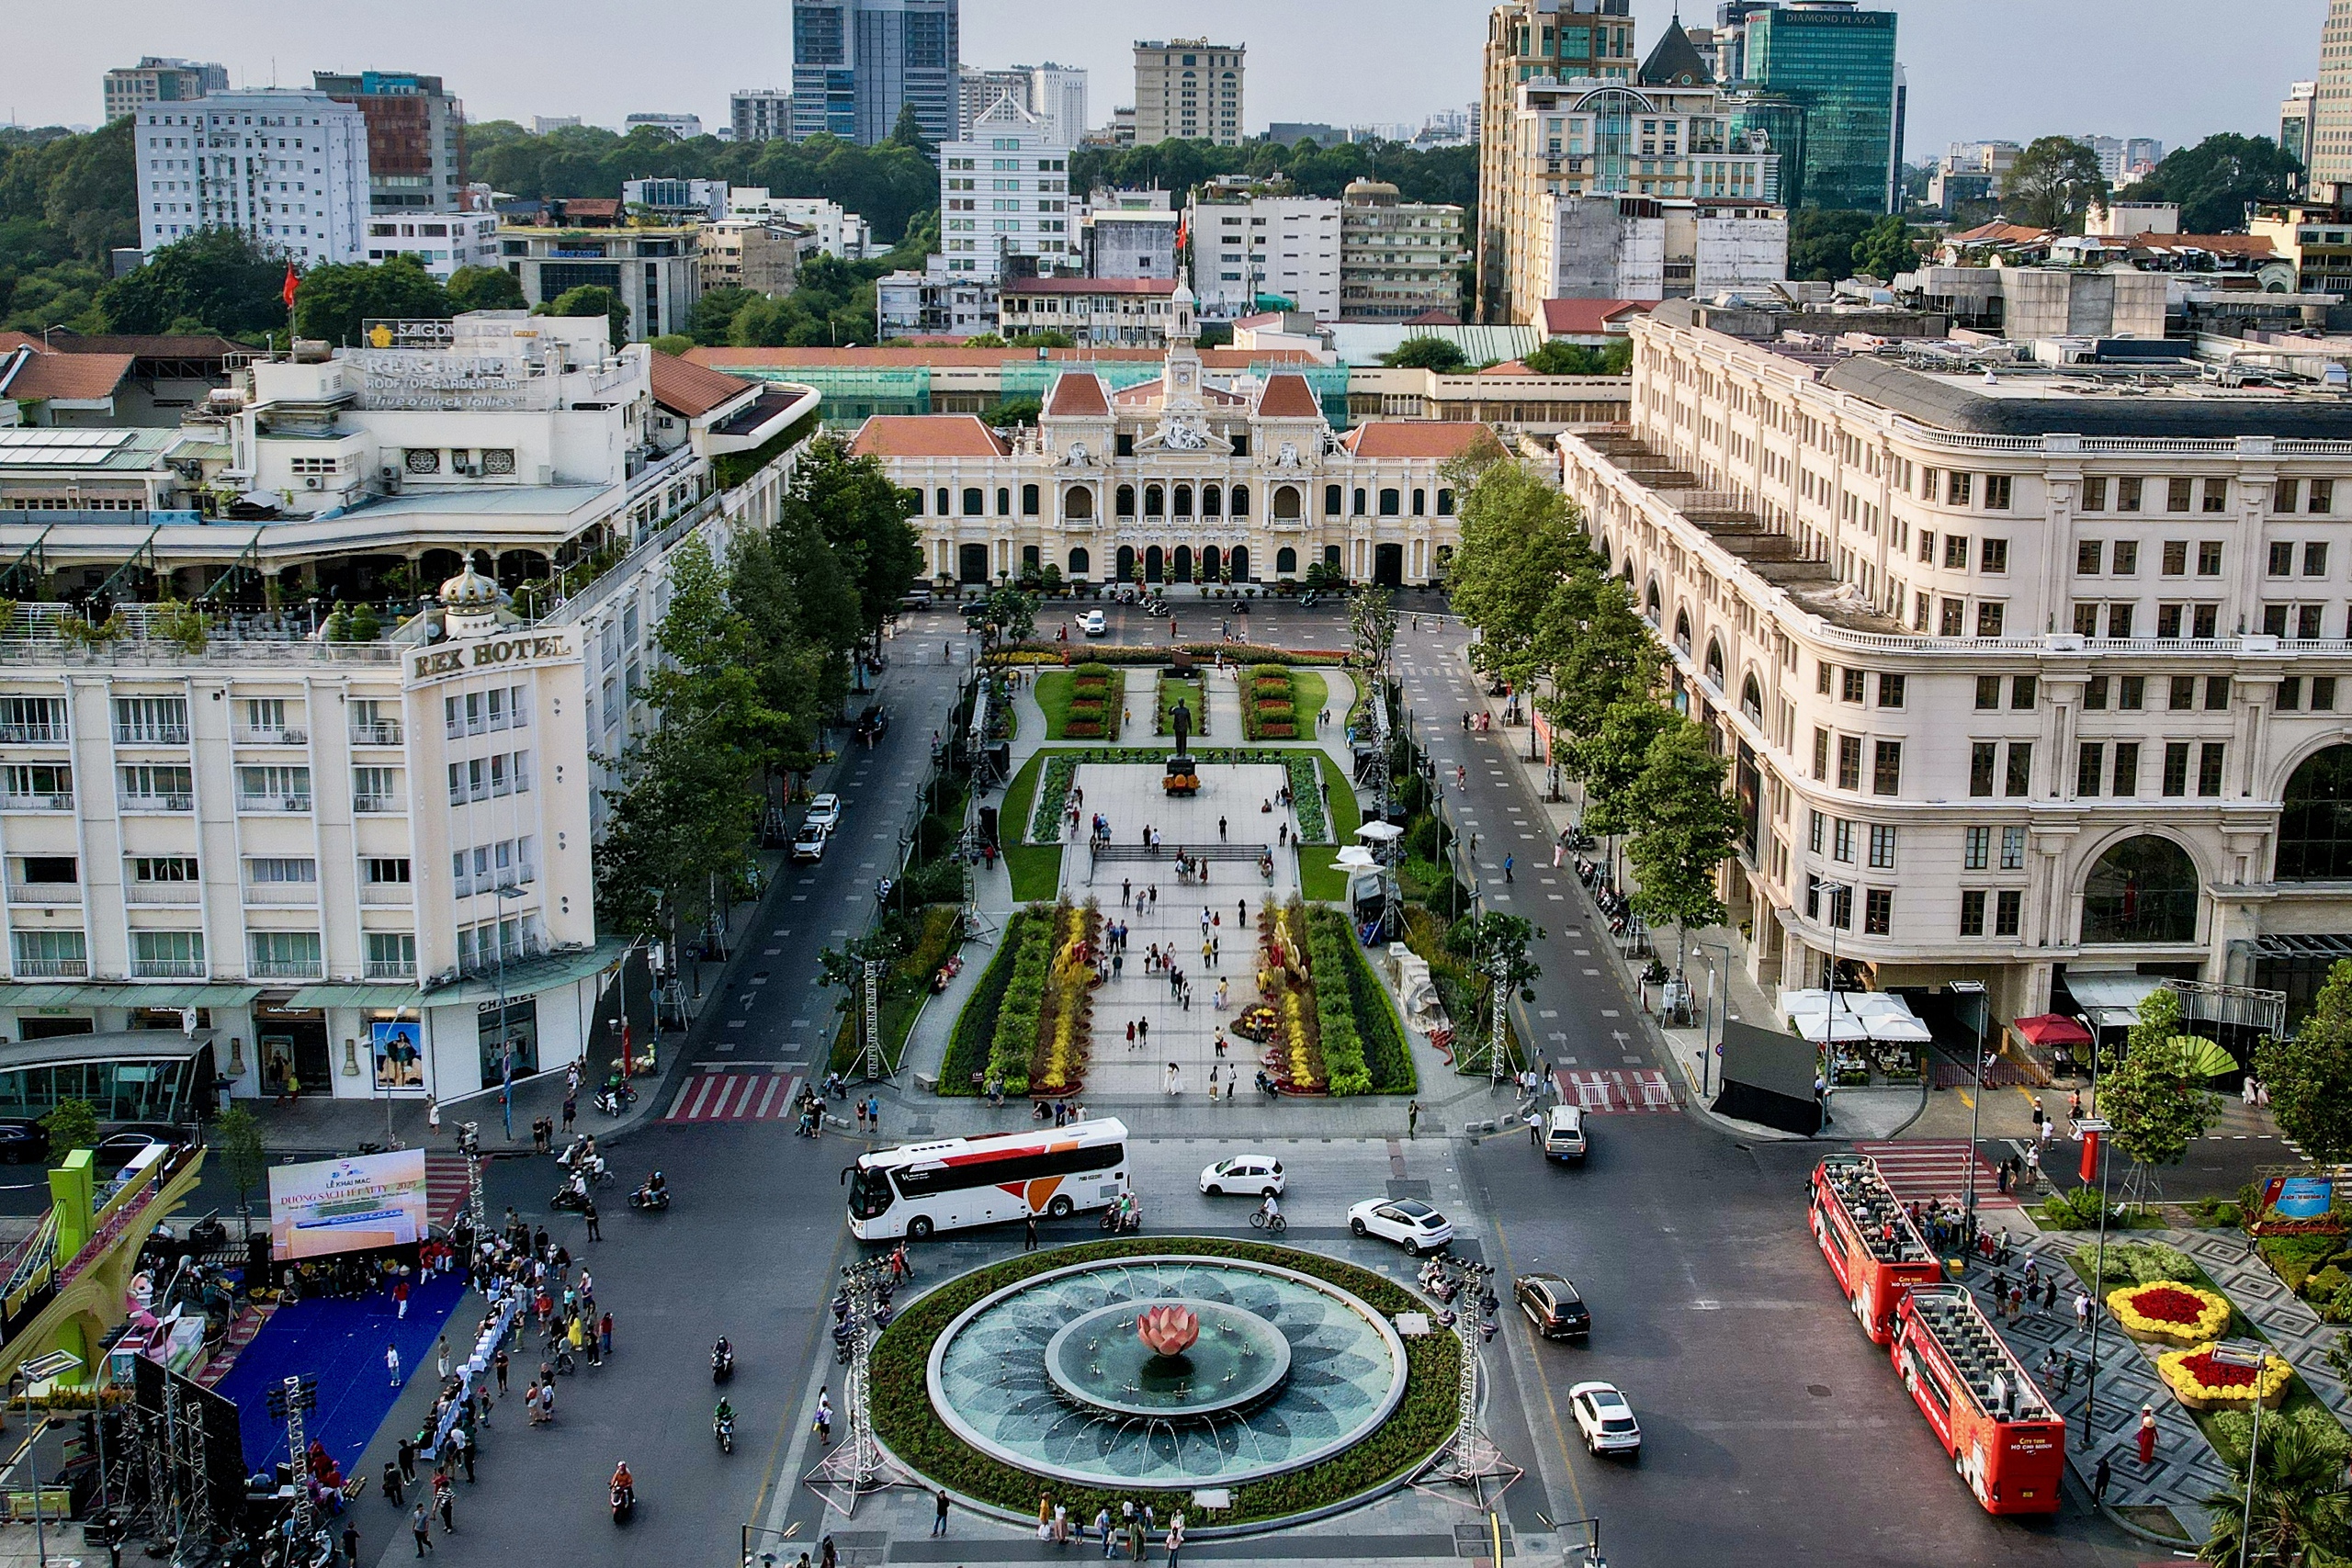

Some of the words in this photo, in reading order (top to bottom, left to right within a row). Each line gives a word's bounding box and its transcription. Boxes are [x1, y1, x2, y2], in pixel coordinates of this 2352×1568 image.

[1786, 14, 1838, 23] DIAMOND
[1842, 15, 1876, 25] PLAZA
[431, 378, 486, 389] GARDEN
[492, 378, 518, 389] BAR
[414, 648, 465, 678] REX
[472, 635, 571, 665] HOTEL
